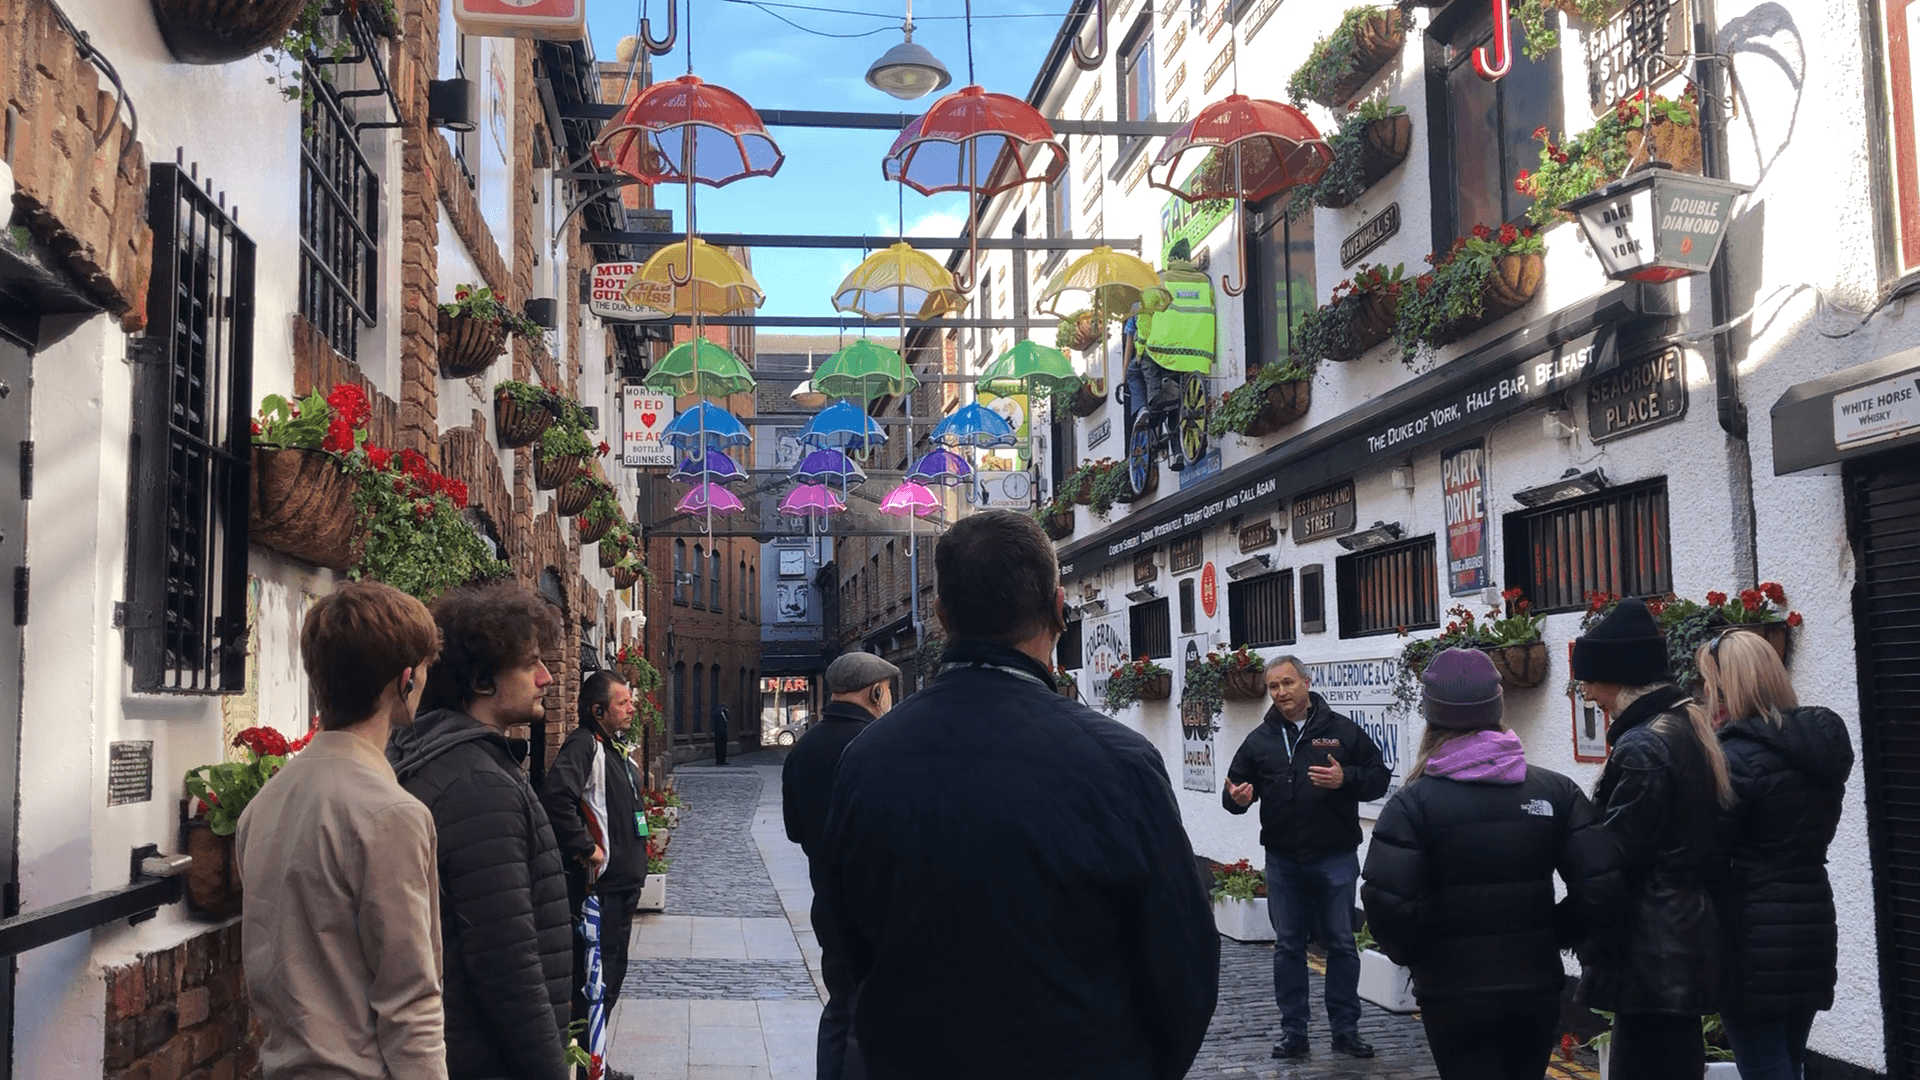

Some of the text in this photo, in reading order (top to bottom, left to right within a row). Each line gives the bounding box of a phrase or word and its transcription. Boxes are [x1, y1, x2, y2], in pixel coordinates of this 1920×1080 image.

[1600, 13, 1670, 80] STREET
[1605, 47, 1666, 106] SOUH
[1602, 204, 1632, 224] DUKE
[1670, 197, 1720, 217] DOUBLE
[1615, 224, 1629, 239] OF
[1661, 215, 1720, 235] DIAMOND
[1341, 219, 1384, 263] RAVENHILL
[1611, 239, 1643, 258] YORK
[597, 265, 641, 276] MUR
[595, 301, 610, 311] THE
[634, 400, 663, 410] RED
[1367, 435, 1386, 453] THE
[1387, 425, 1416, 446] DUKE
[1415, 416, 1430, 434] OF
[1430, 403, 1462, 428] YORK,
[1466, 386, 1497, 414] HALF
[1535, 344, 1596, 386] BELFAST
[1841, 387, 1912, 416] WHITE HORSE
[1606, 392, 1660, 432] PLACE
[1859, 409, 1892, 426] WHISKY
[626, 455, 672, 464] GUINNESS
[633, 445, 664, 453] BOTTLED
[1443, 449, 1480, 490] PARK
[1184, 510, 1203, 526] DEPART
[1225, 495, 1238, 510] AND
[1239, 490, 1255, 503] CALL
[1255, 478, 1276, 498] AGAIN
[1446, 486, 1484, 526] DRIVE
[1305, 511, 1335, 535] STREET
[1086, 623, 1122, 665] COLERAINE
[1327, 662, 1374, 688] ALDERDICE
[1375, 665, 1381, 685] &
[1322, 691, 1361, 701] NEWRY
[1184, 743, 1211, 767] LIQUEUR
